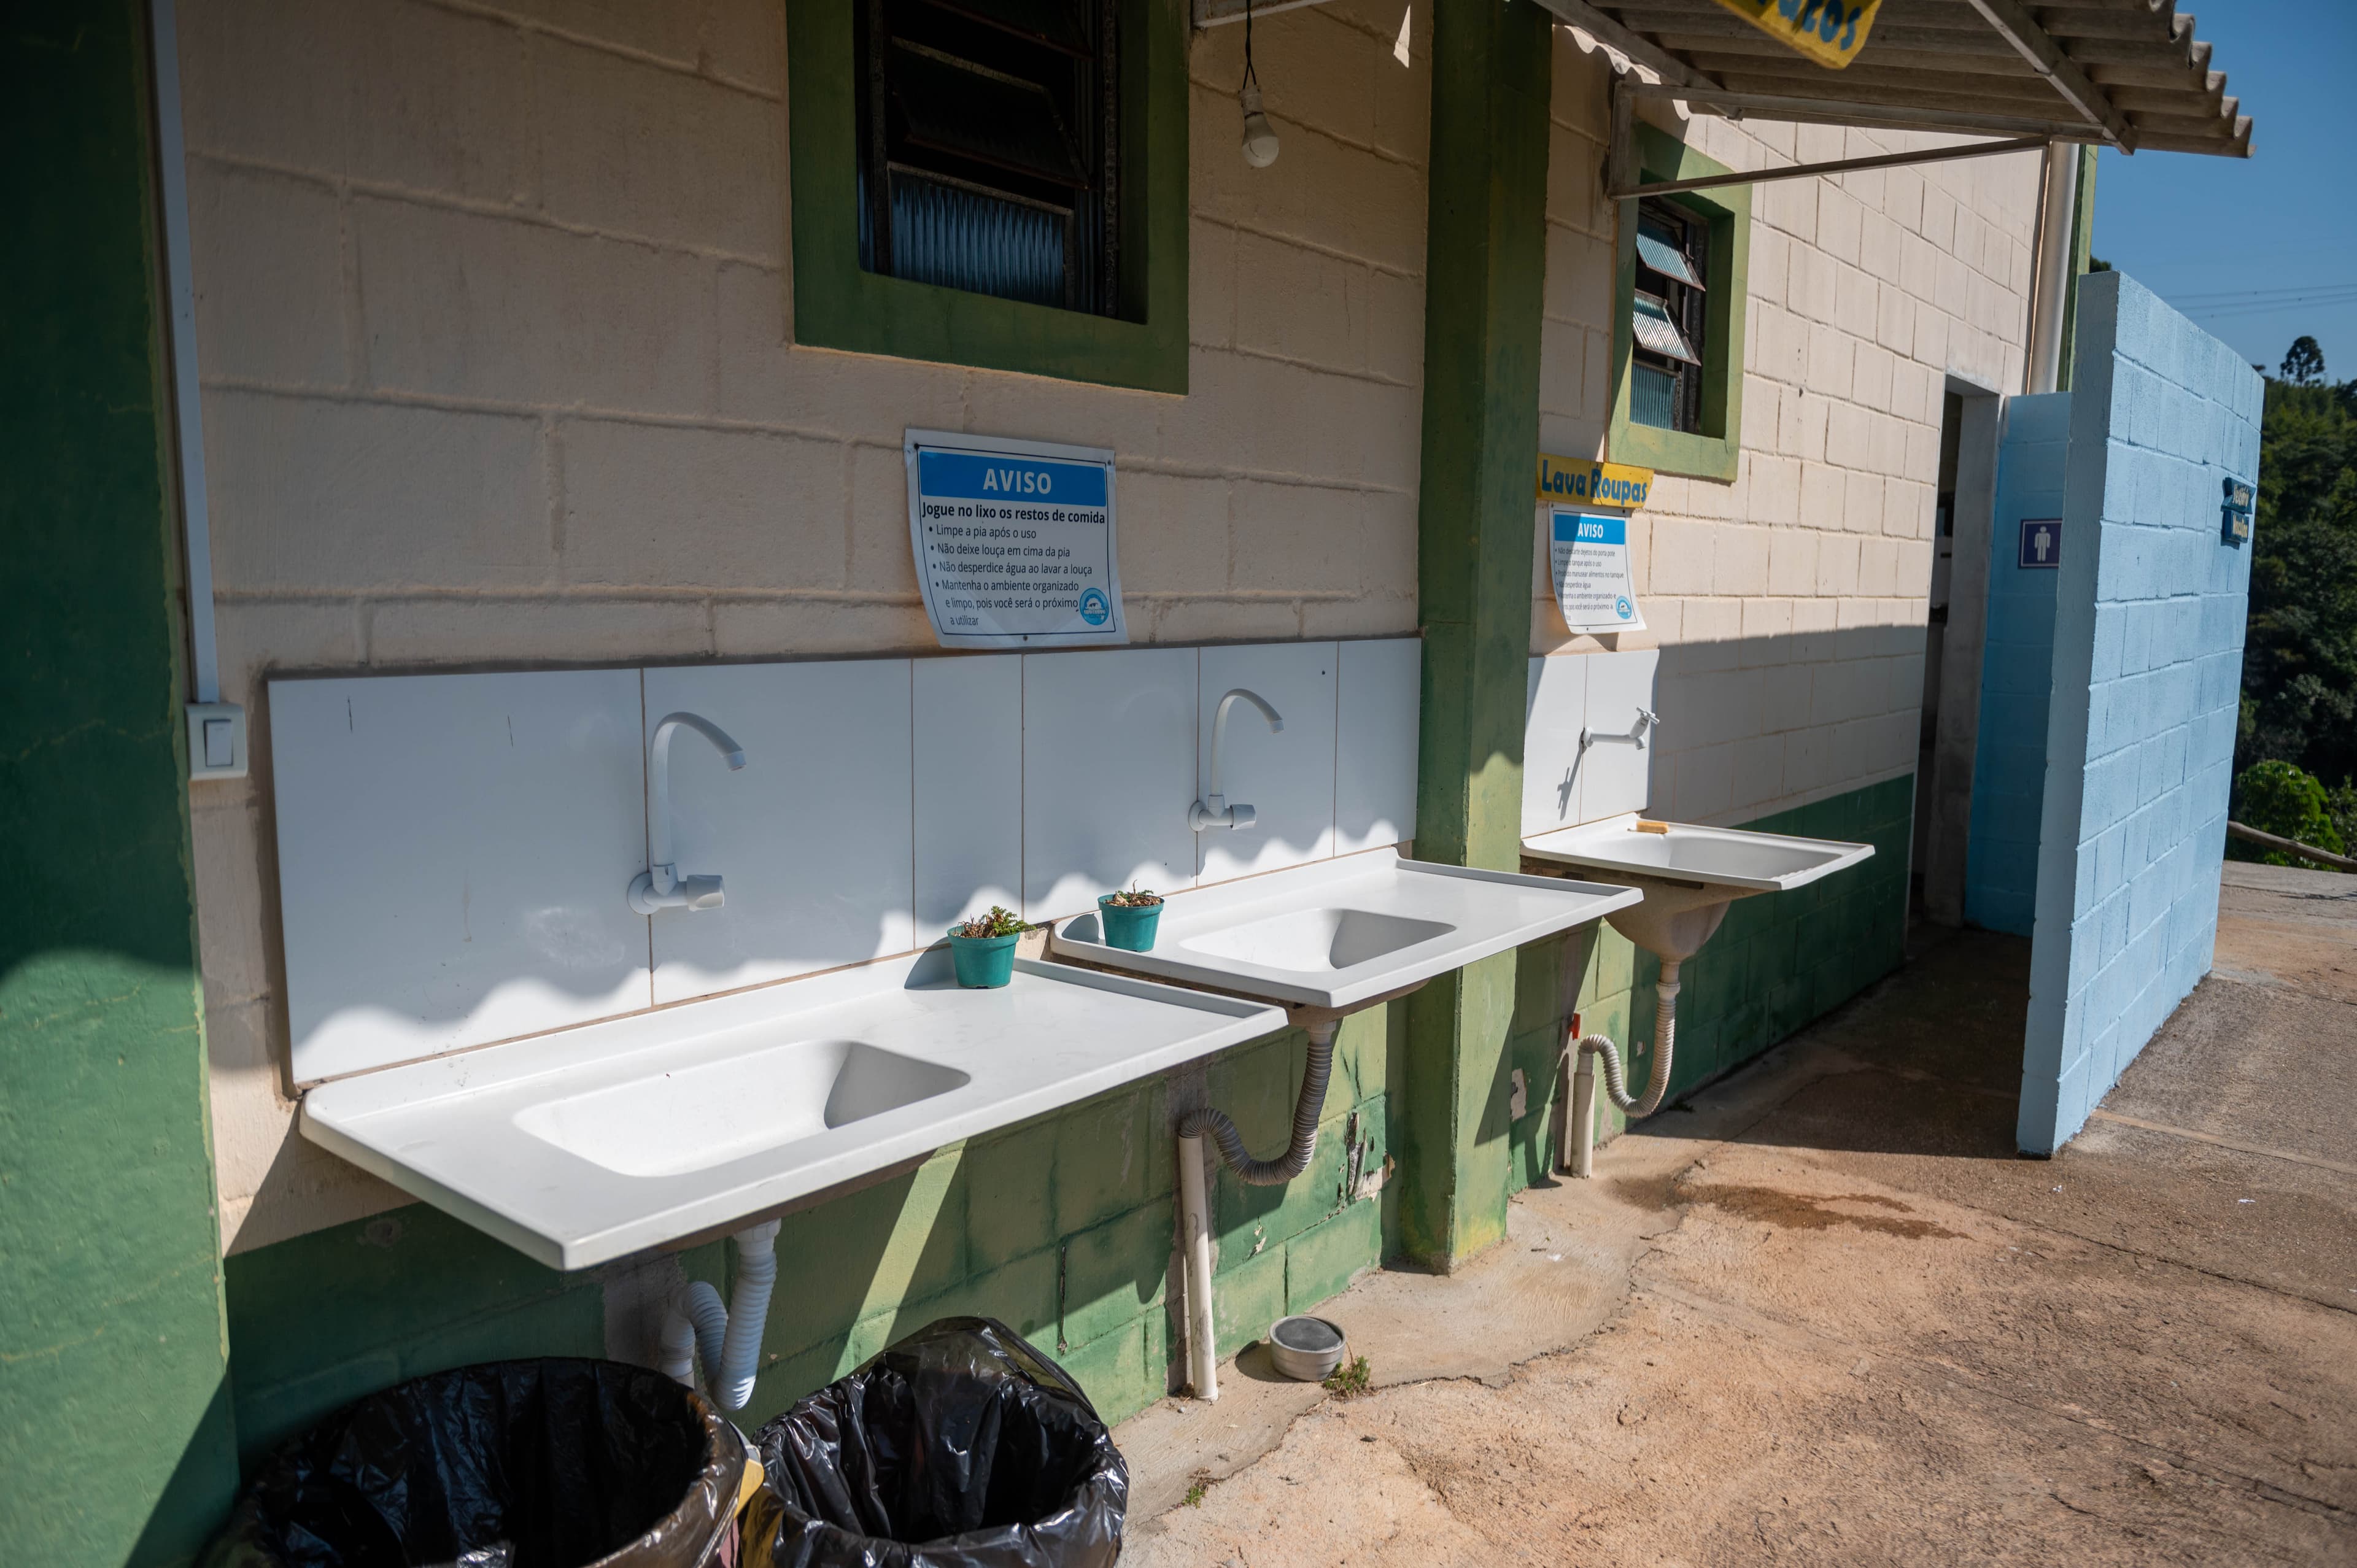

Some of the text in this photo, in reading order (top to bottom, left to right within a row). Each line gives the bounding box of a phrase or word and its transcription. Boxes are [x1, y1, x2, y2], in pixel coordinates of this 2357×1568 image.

[983, 468, 1051, 494] AVISO
[1541, 460, 1647, 506] Lava Roupas
[922, 502, 1105, 523] Jogue no lixo os restos de comida
[936, 524, 1036, 540] Limpe a pia após o uso
[1577, 523, 1603, 538] AVISO
[938, 543, 1070, 560] Não deixe louça em cima da pia
[940, 562, 956, 572] Não
[958, 562, 1003, 576] desperdice
[1006, 563, 1026, 577] água
[1042, 563, 1061, 574] lavar
[1071, 563, 1092, 577] louça
[942, 579, 1078, 593] Mantenha o ambiente organizado
[951, 598, 975, 611] limpo,
[977, 598, 992, 610] pois
[994, 597, 1013, 608] você
[1015, 598, 1032, 608] será
[1035, 599, 1040, 608] o
[1043, 597, 1078, 610] próximo
[956, 616, 978, 625] utilizar
